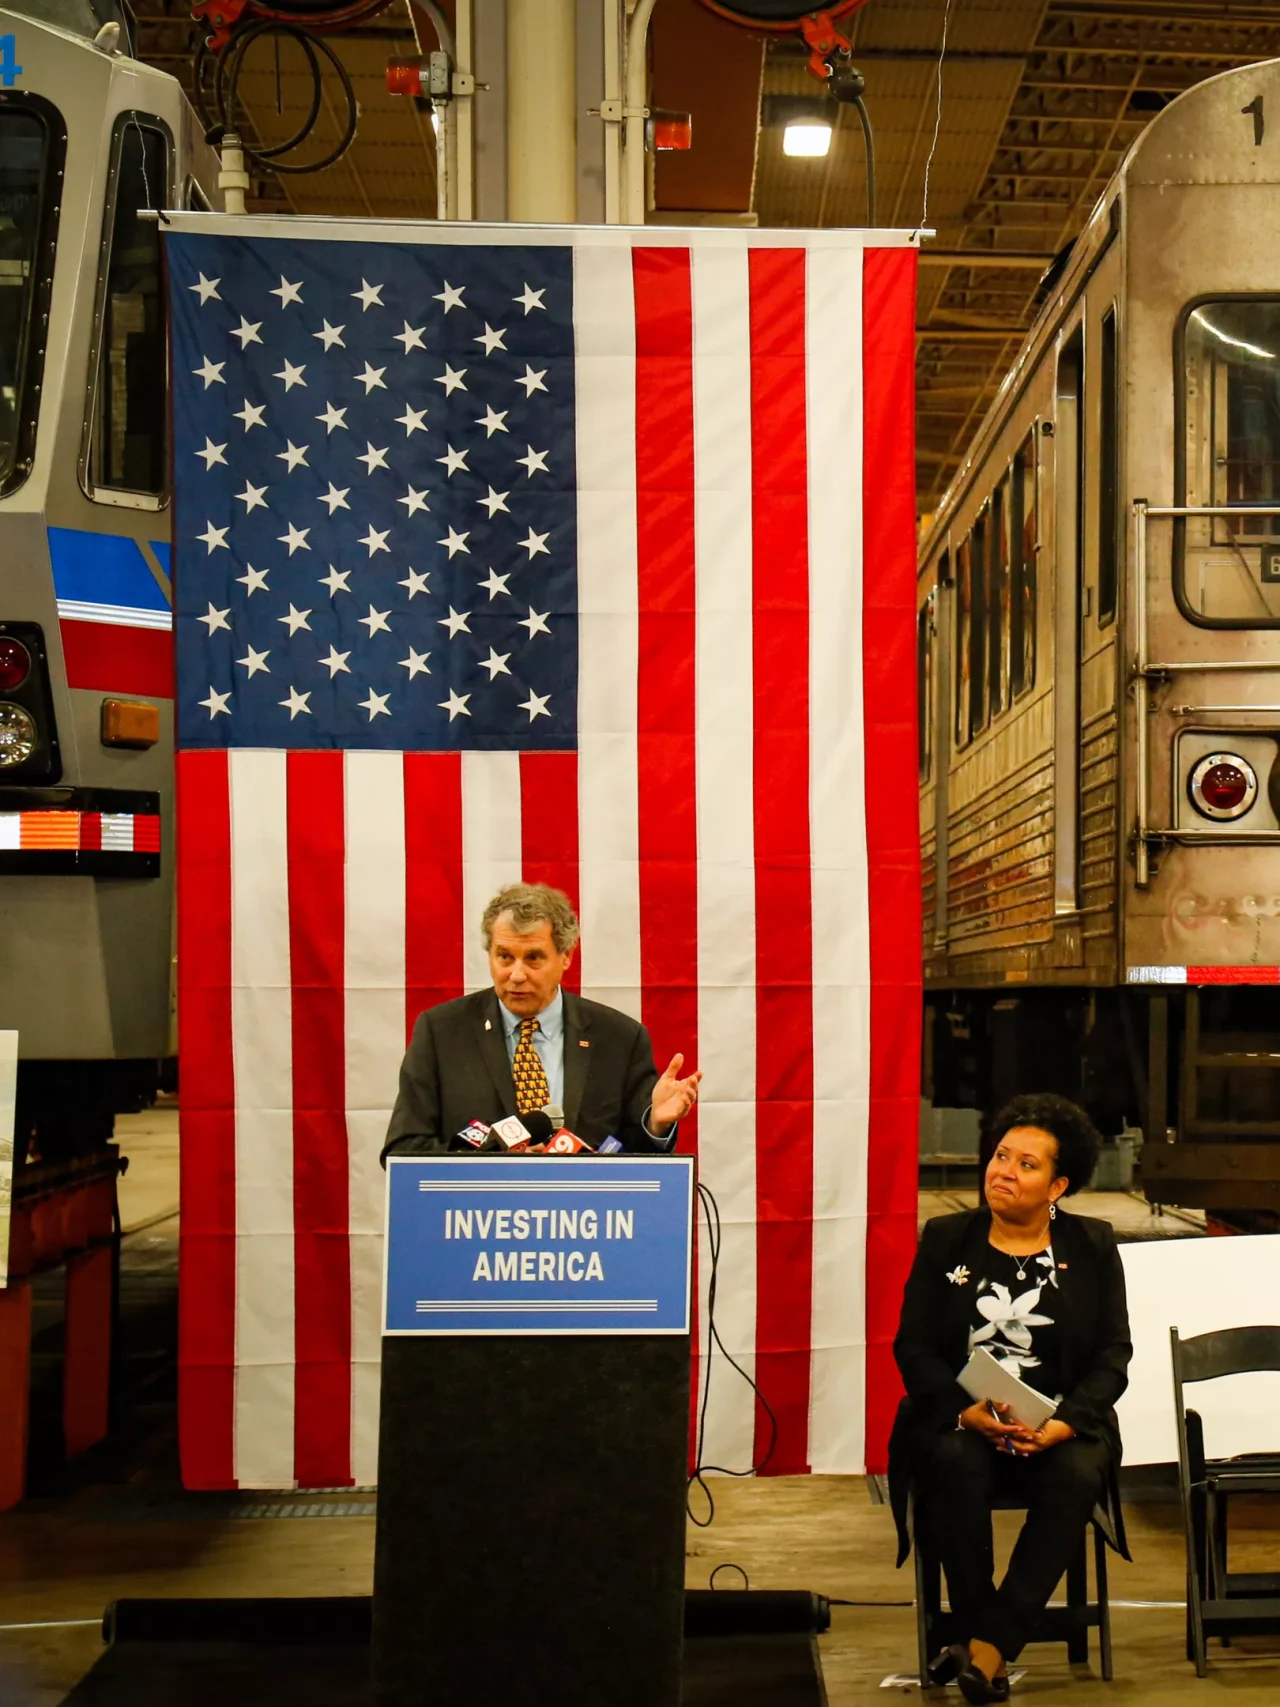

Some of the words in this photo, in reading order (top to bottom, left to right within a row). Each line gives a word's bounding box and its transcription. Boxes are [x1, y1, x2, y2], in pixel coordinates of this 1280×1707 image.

[444, 1209, 598, 1240] INVESTING
[605, 1209, 634, 1240] IN
[472, 1251, 604, 1282] AMERICA
